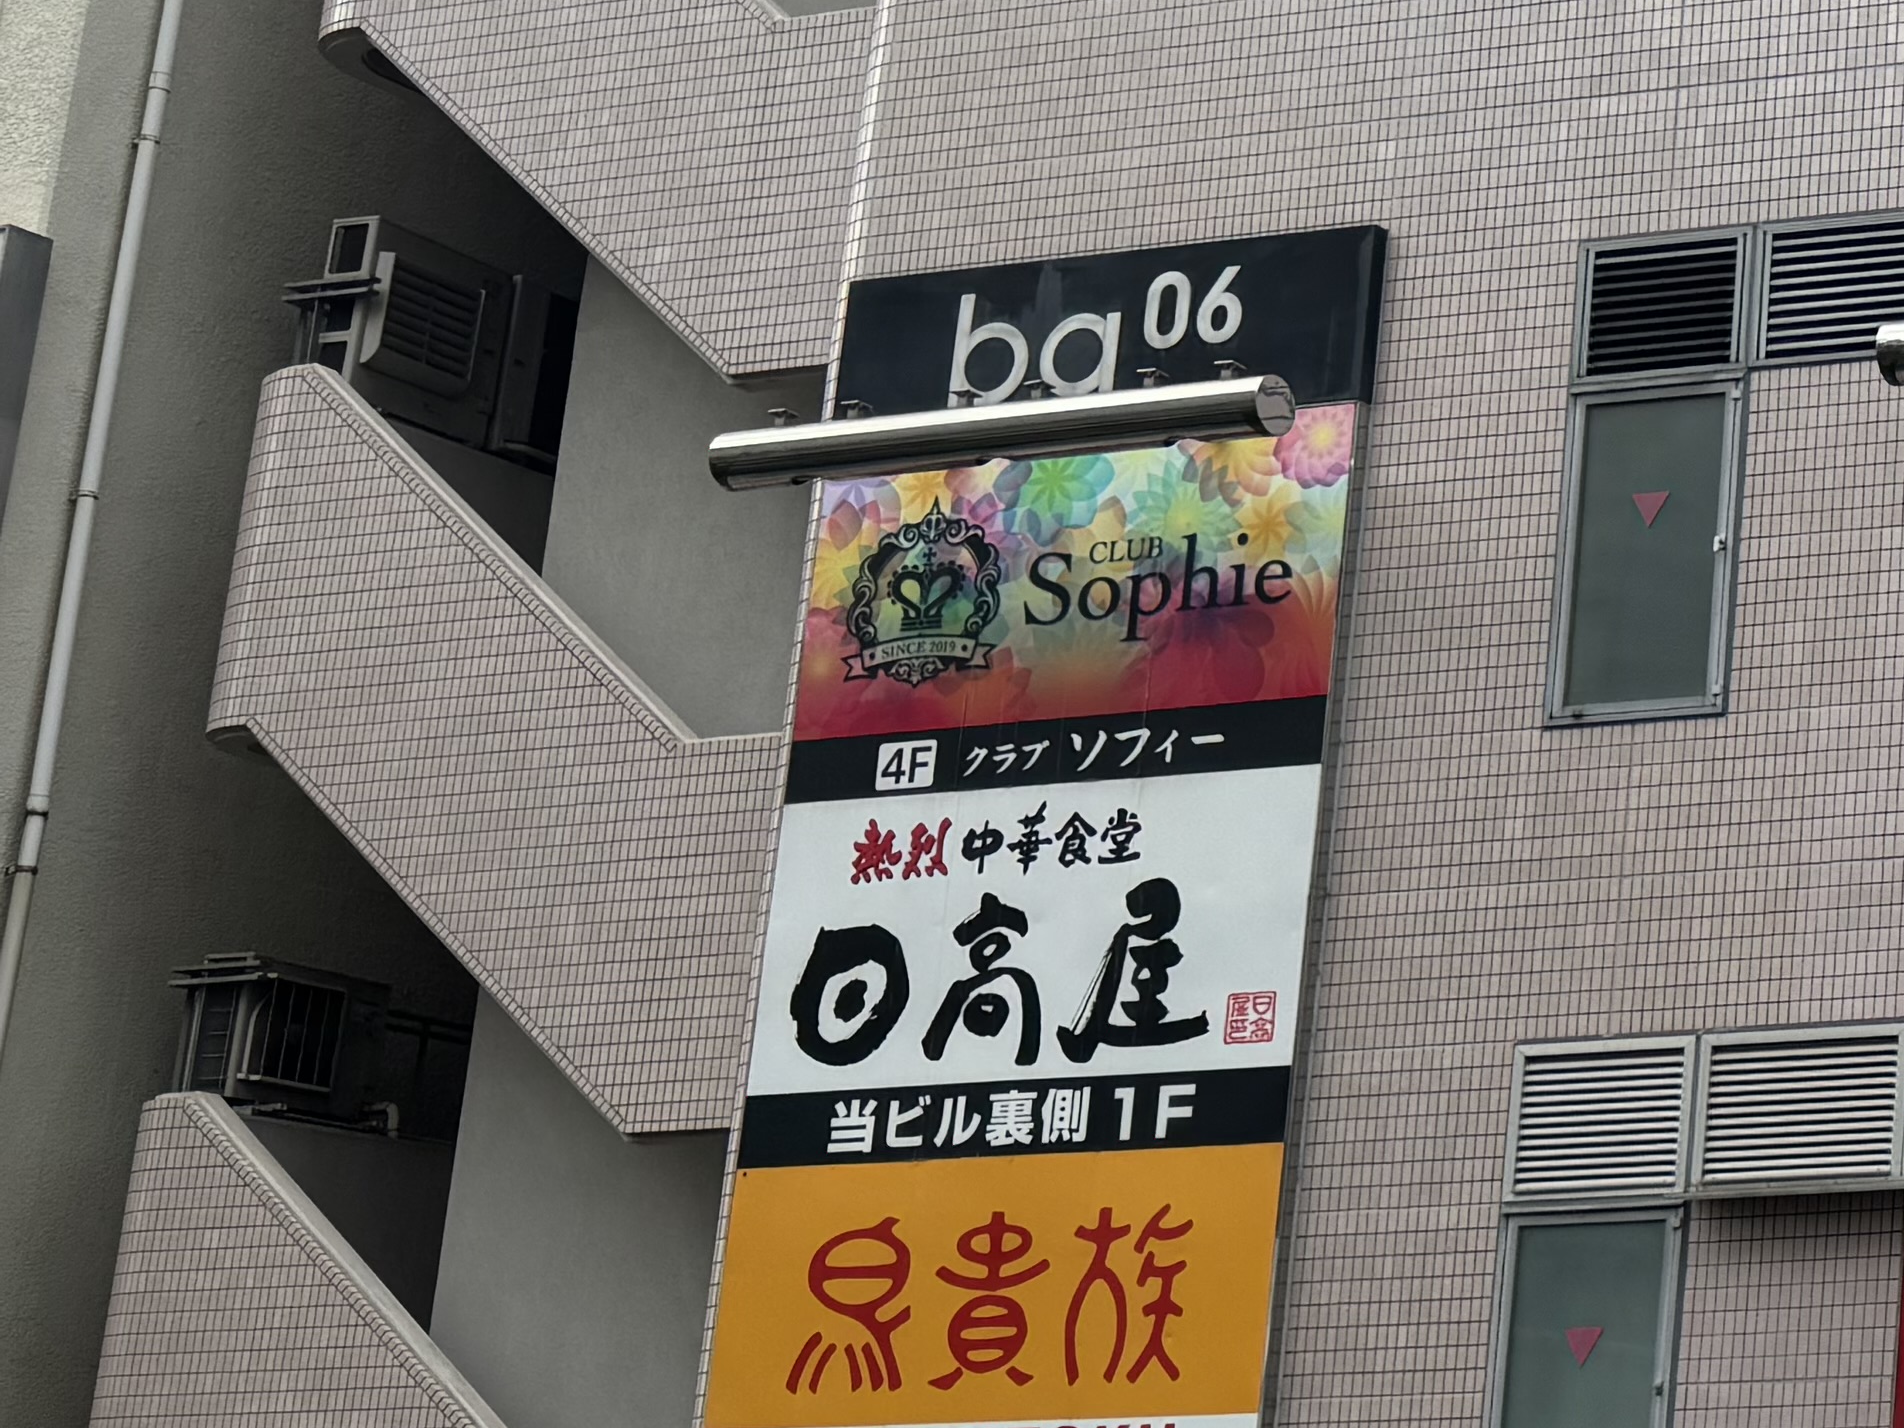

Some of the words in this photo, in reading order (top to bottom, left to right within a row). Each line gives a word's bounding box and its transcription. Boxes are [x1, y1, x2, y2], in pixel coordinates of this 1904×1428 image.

[1144, 265, 1242, 349] 06
[1023, 532, 1293, 642] Sophie
[1089, 536, 1163, 565] CLUB
[881, 641, 926, 661] SINCE
[928, 639, 956, 655] 2019
[881, 745, 932, 786] 4F
[963, 740, 1051, 776] クラブ
[1069, 727, 1225, 771] ソフィー
[791, 877, 1209, 1067] 日高屋
[785, 1203, 1194, 1395] 鳥貴族
